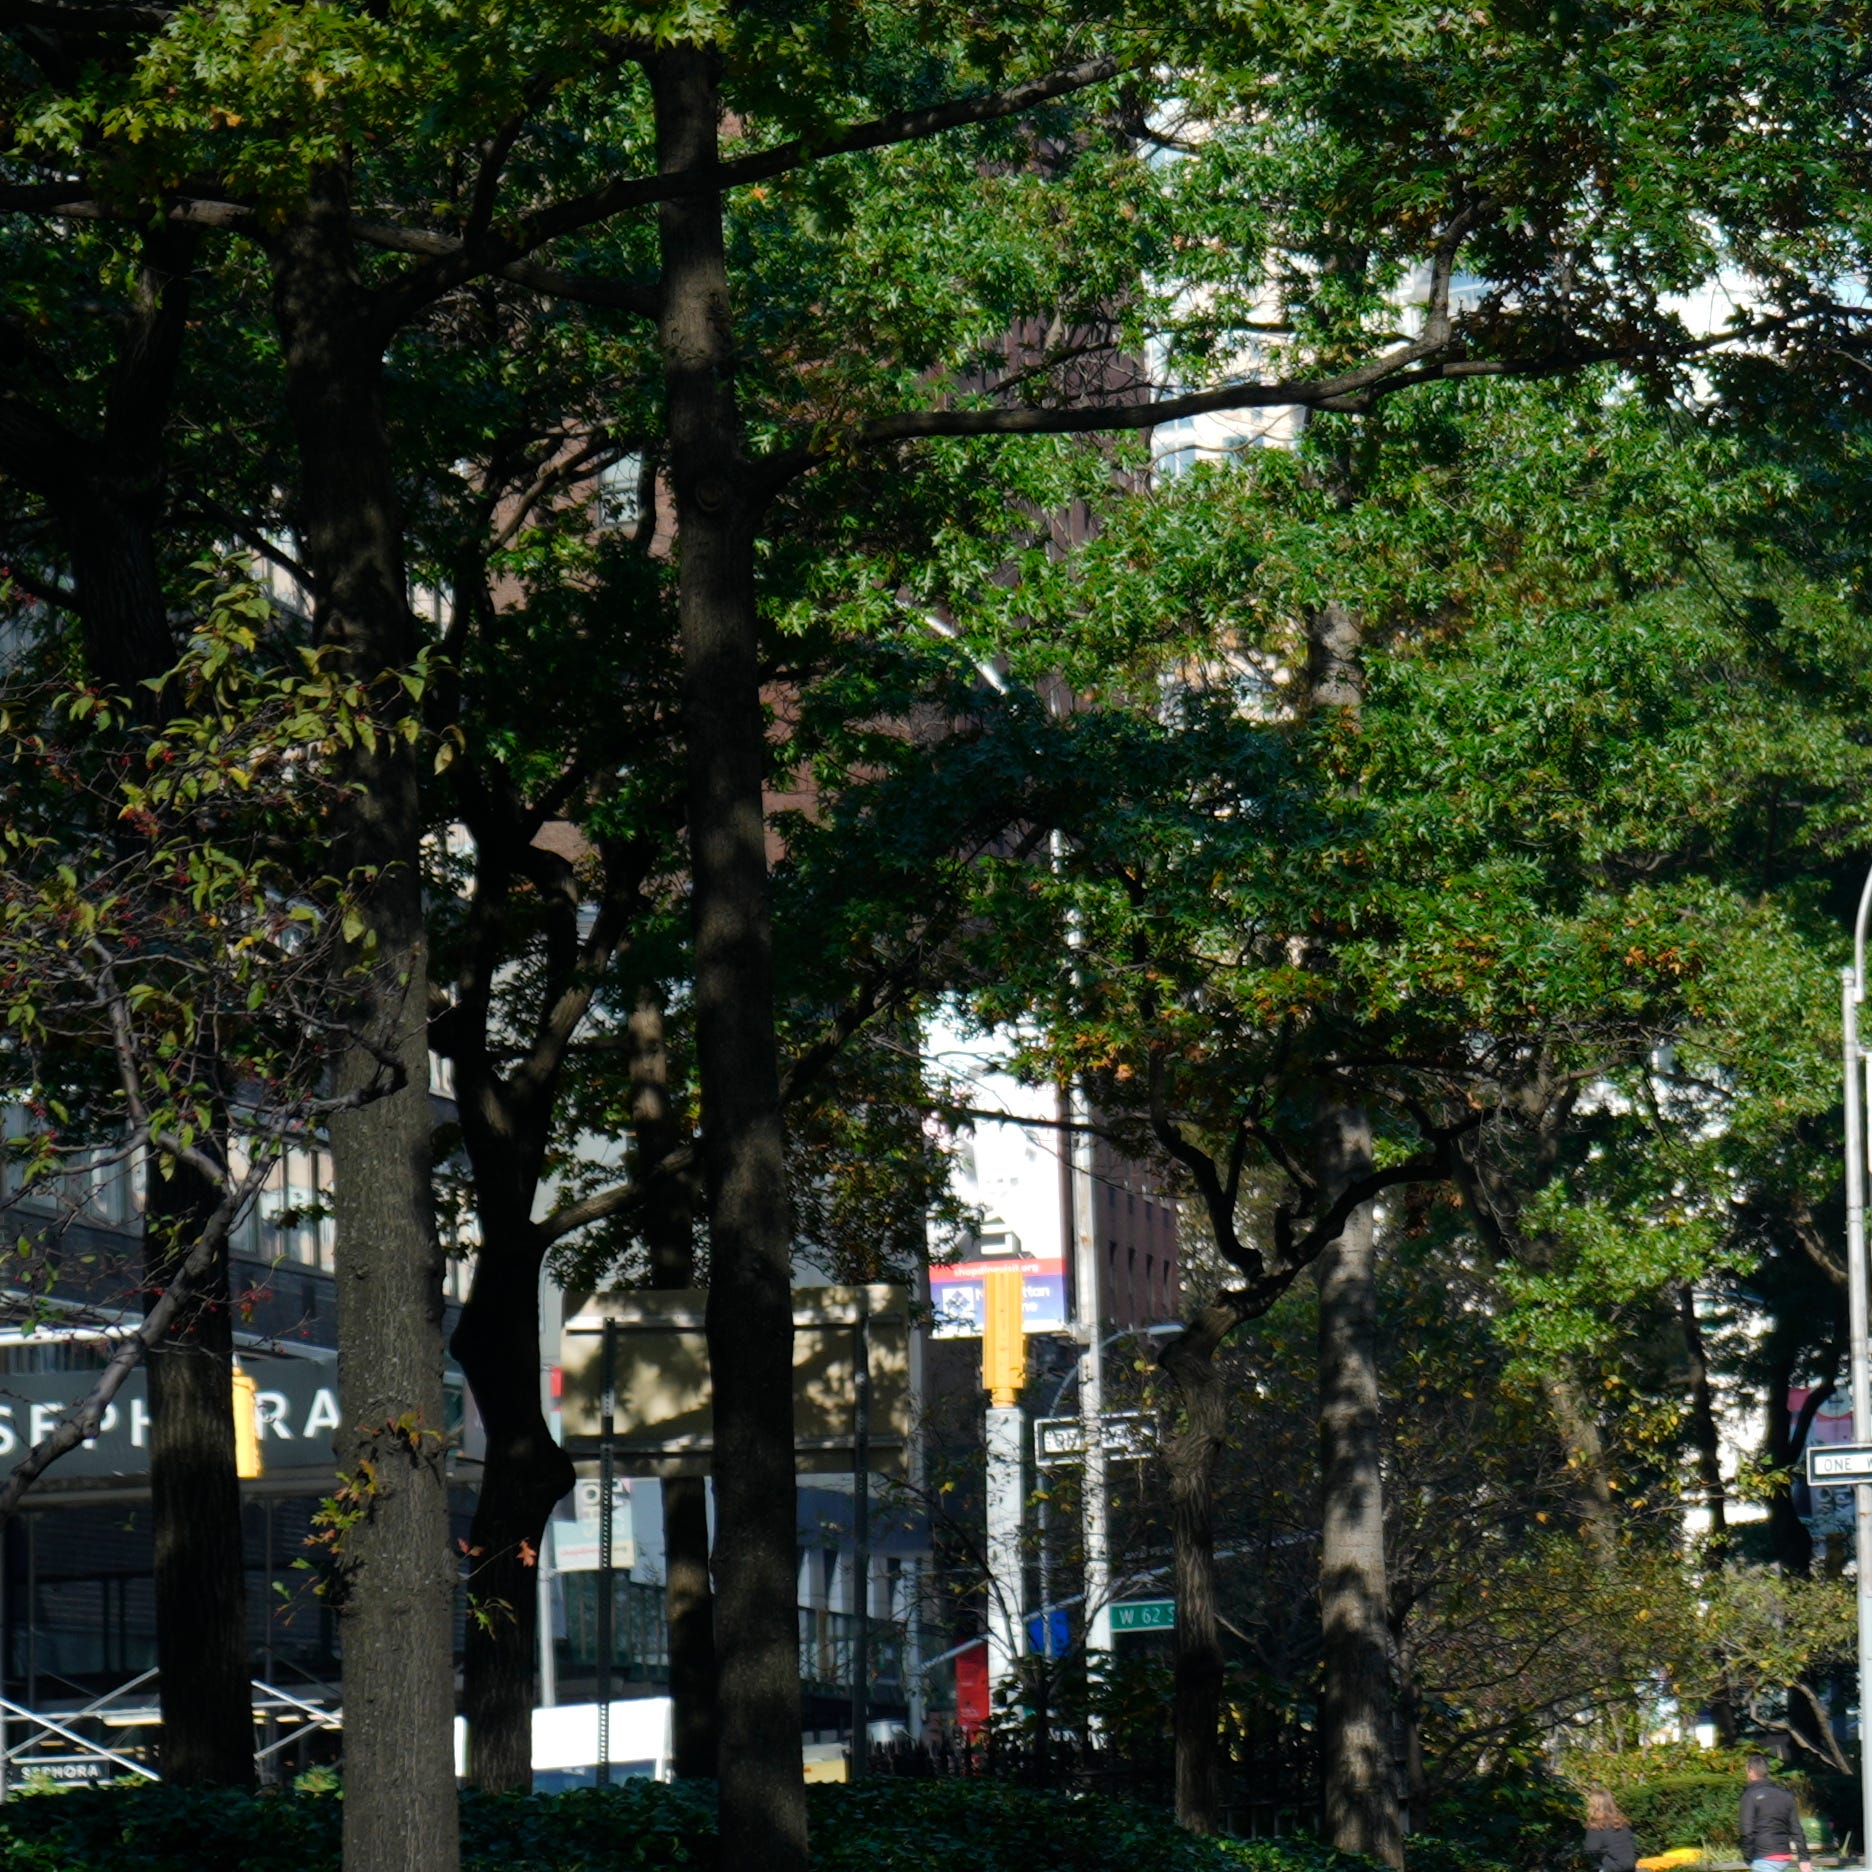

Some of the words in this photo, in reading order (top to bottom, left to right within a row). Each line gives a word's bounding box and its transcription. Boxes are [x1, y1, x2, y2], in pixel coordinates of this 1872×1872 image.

[0, 1387, 340, 1456] SEPHRA
[1824, 1458, 1852, 1472] ONE
[1119, 1609, 1134, 1625] W
[1142, 1608, 1160, 1624] 62
